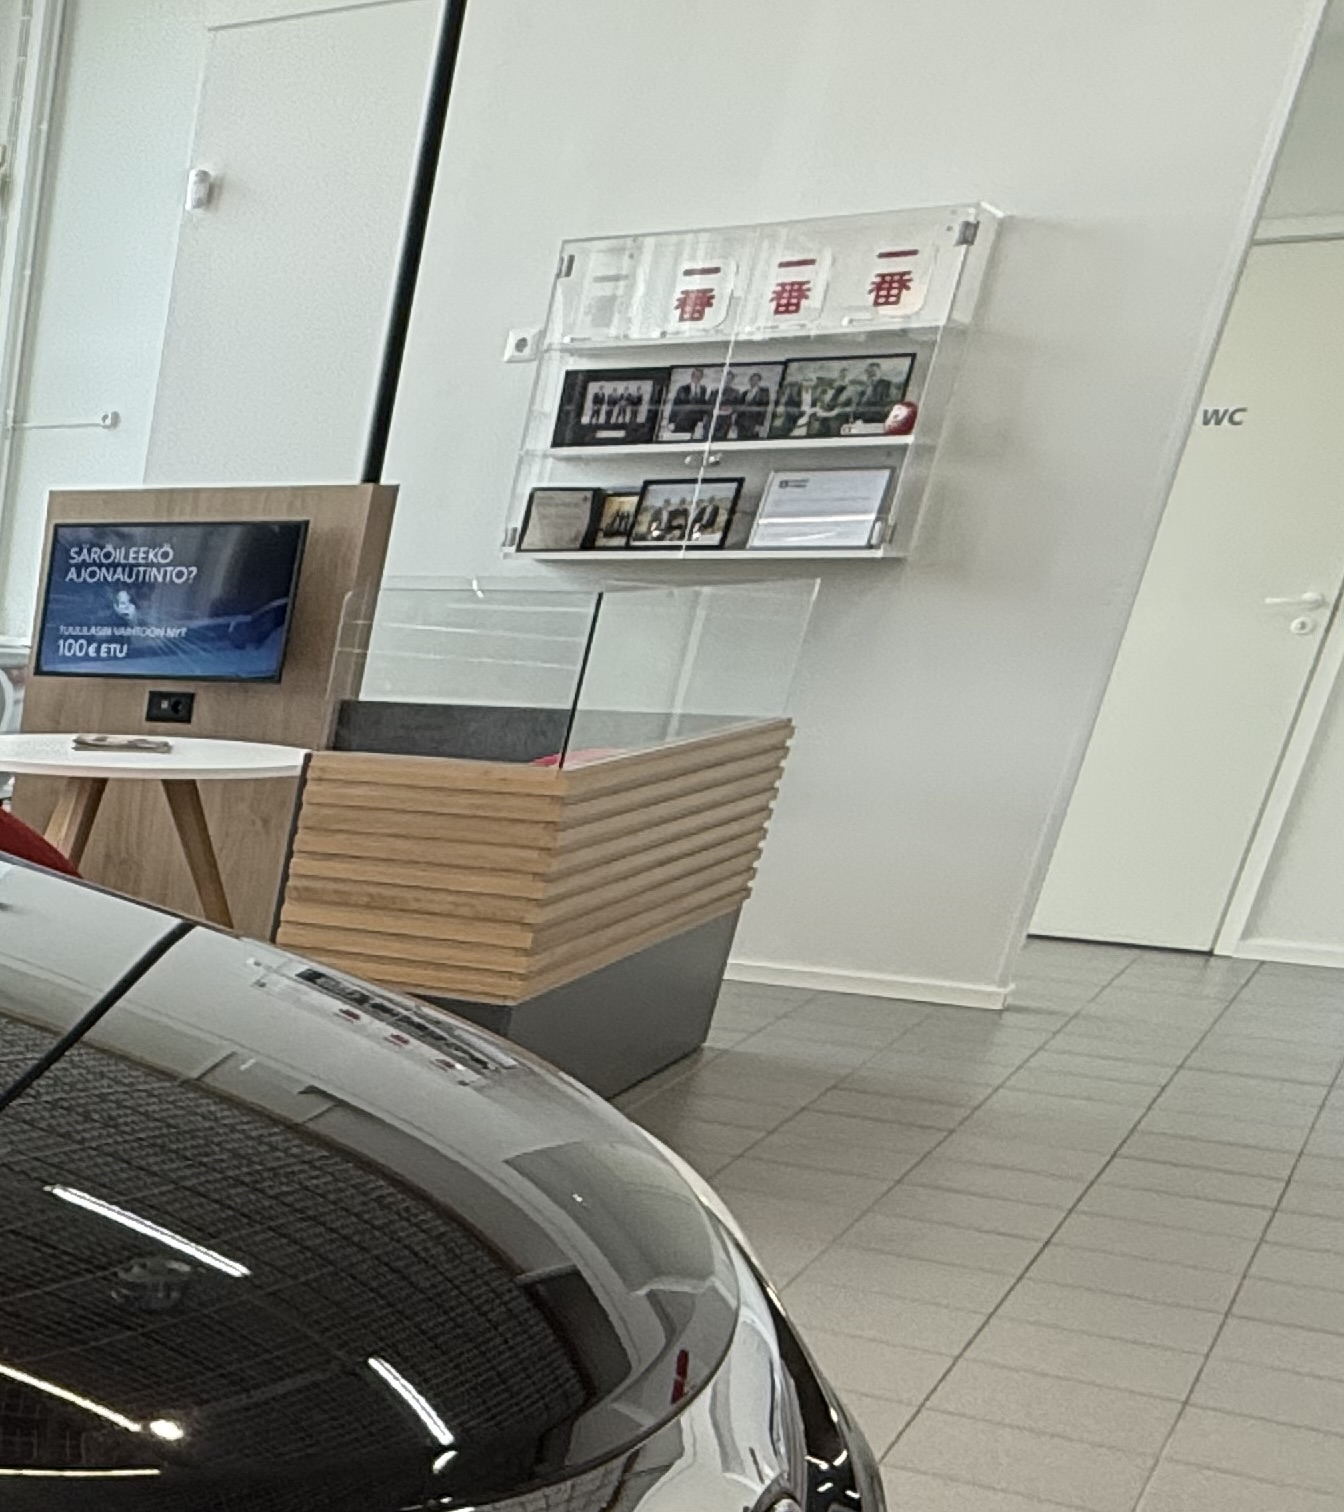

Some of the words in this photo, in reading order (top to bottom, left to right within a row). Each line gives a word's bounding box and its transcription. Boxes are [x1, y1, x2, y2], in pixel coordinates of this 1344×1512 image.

[1202, 407, 1248, 426] WC
[68, 543, 174, 564] SÄRÖILEEKÖ
[65, 566, 198, 585] AJONAUTINTO?
[99, 643, 128, 658] ETU
